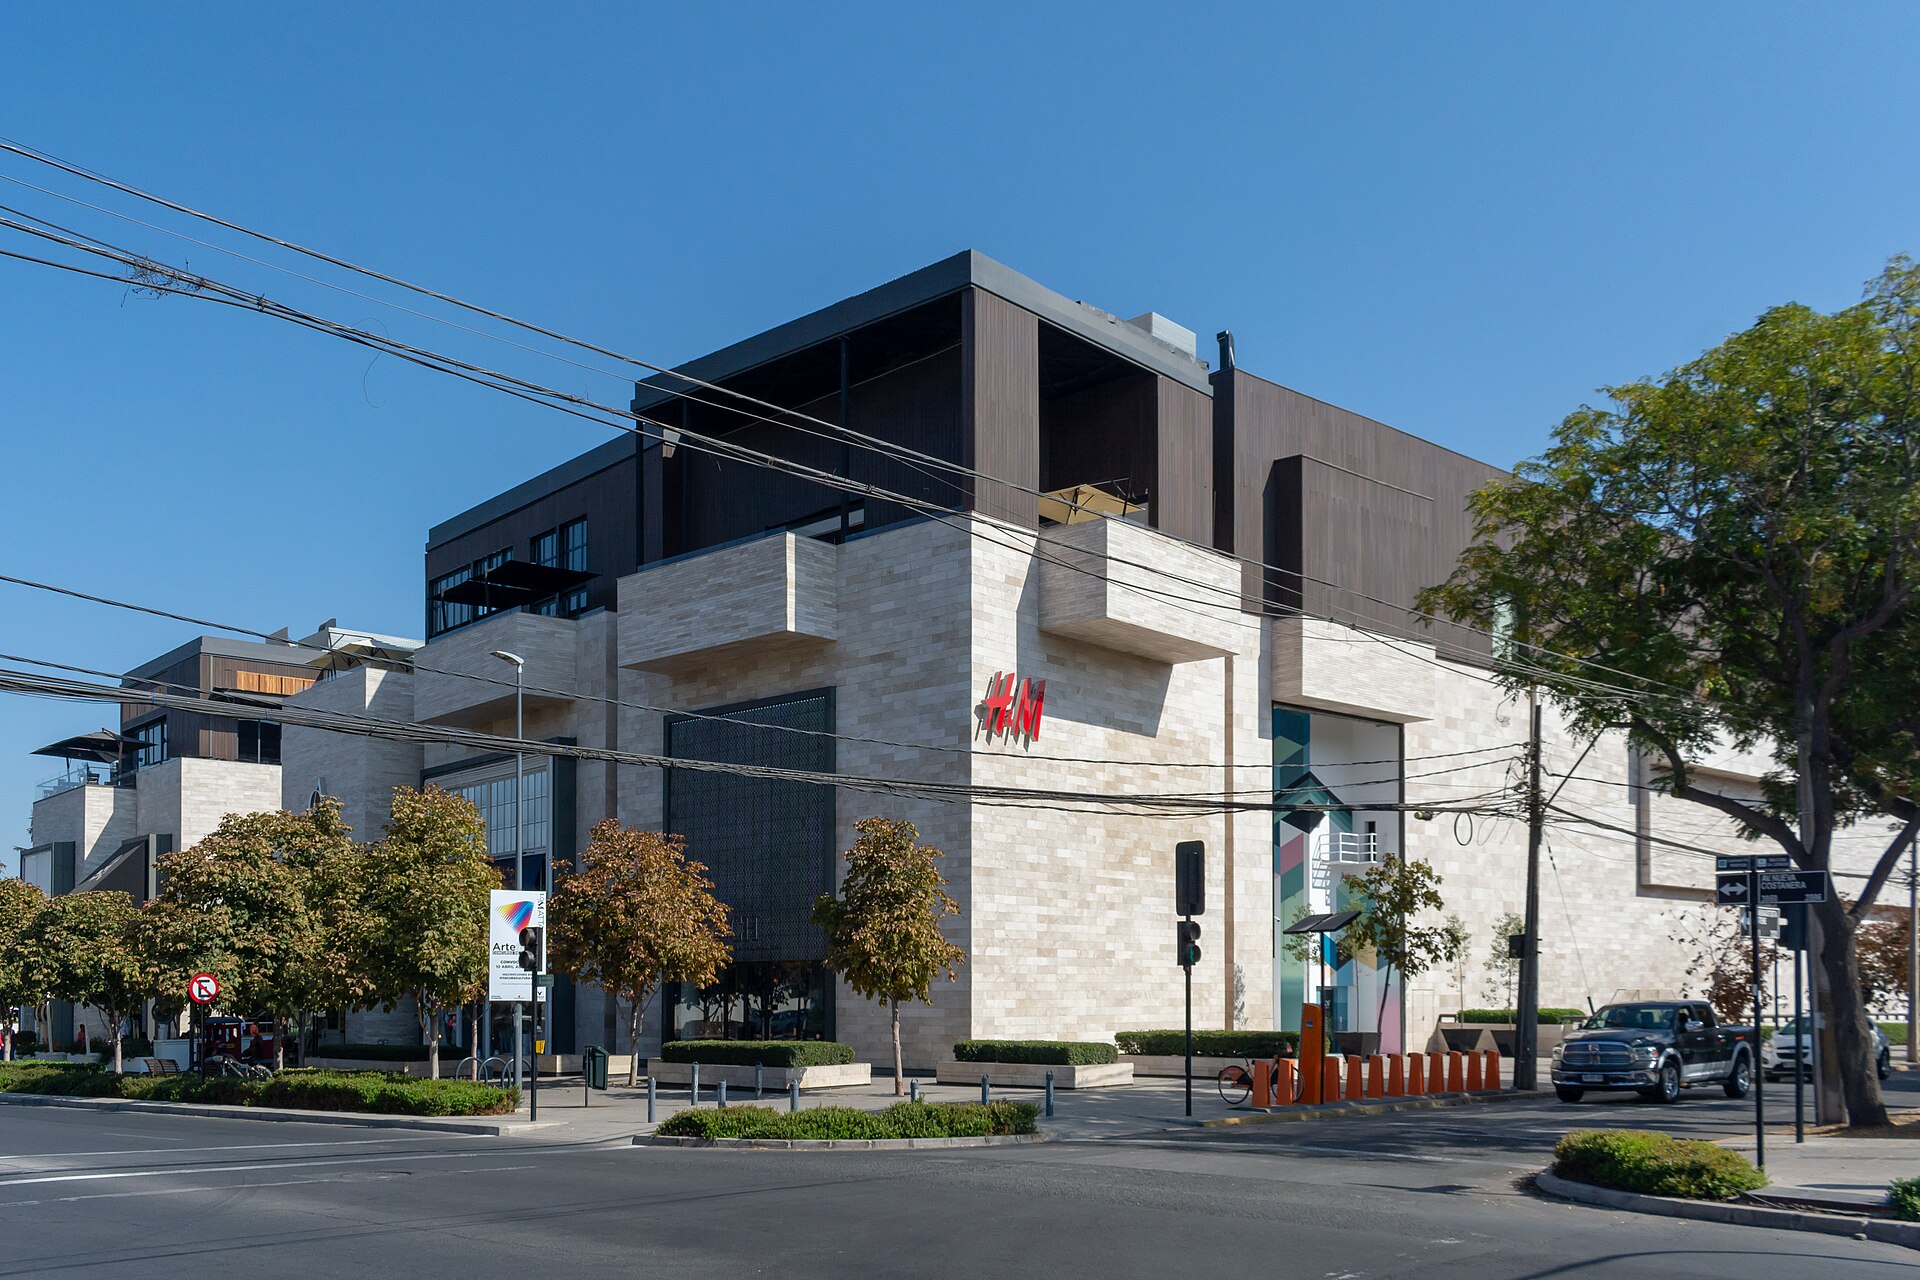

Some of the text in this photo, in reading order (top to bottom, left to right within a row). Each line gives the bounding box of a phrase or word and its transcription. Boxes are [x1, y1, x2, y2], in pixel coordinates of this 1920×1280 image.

[981, 671, 1046, 742] H&M
[1761, 881, 1807, 889] COSTANERA
[492, 942, 516, 951] Arte
